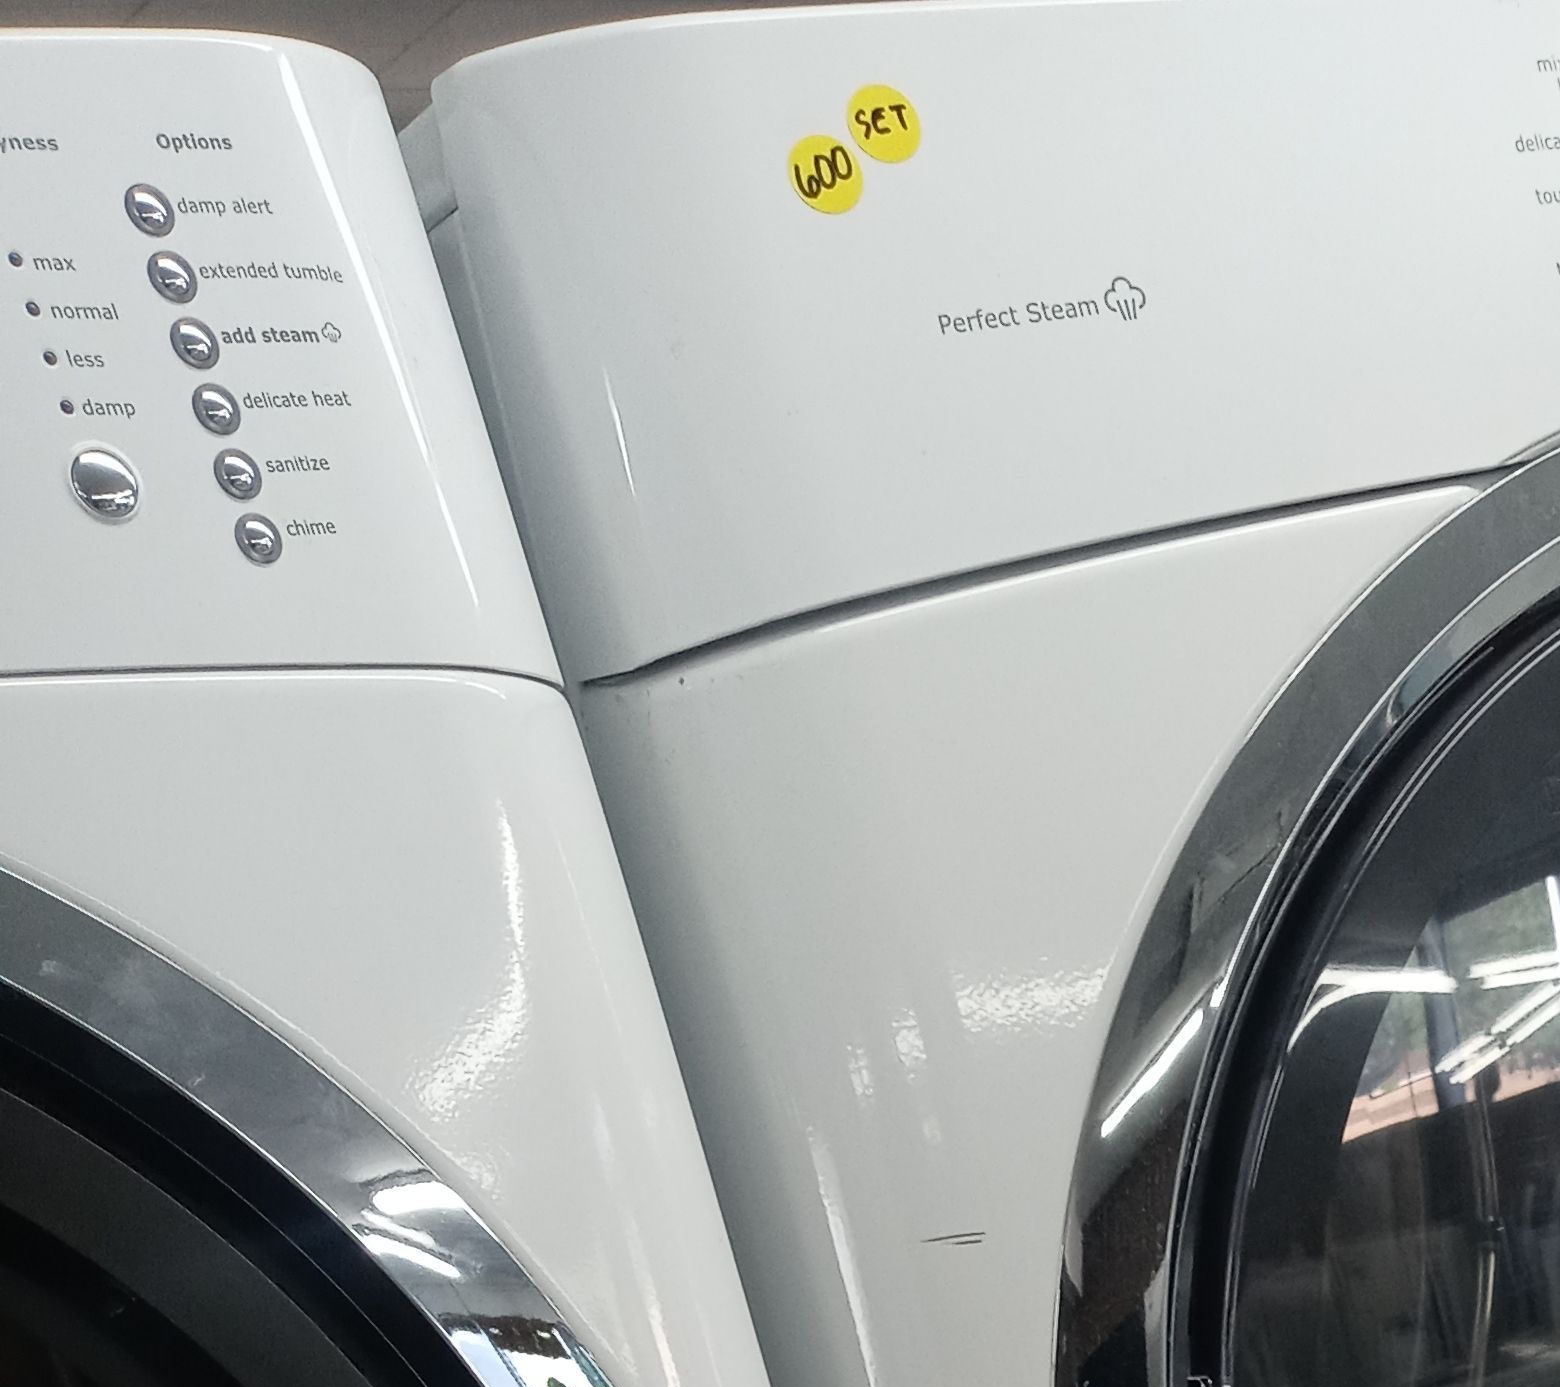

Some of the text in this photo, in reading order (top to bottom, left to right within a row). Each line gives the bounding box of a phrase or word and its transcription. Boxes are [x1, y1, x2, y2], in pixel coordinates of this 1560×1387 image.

[854, 103, 908, 140] SET
[156, 132, 234, 153] Options
[793, 144, 854, 200] 600
[177, 196, 274, 217] damp alert
[32, 255, 77, 273] max
[199, 262, 345, 284] extended tumble
[50, 302, 120, 322] normal
[937, 298, 1101, 336] Perfect Steam
[221, 325, 322, 345] add steam
[66, 349, 106, 369] less
[82, 398, 137, 419] damp
[242, 389, 352, 411] delicate heat
[265, 455, 331, 475] sanitize
[286, 517, 338, 539] chime
